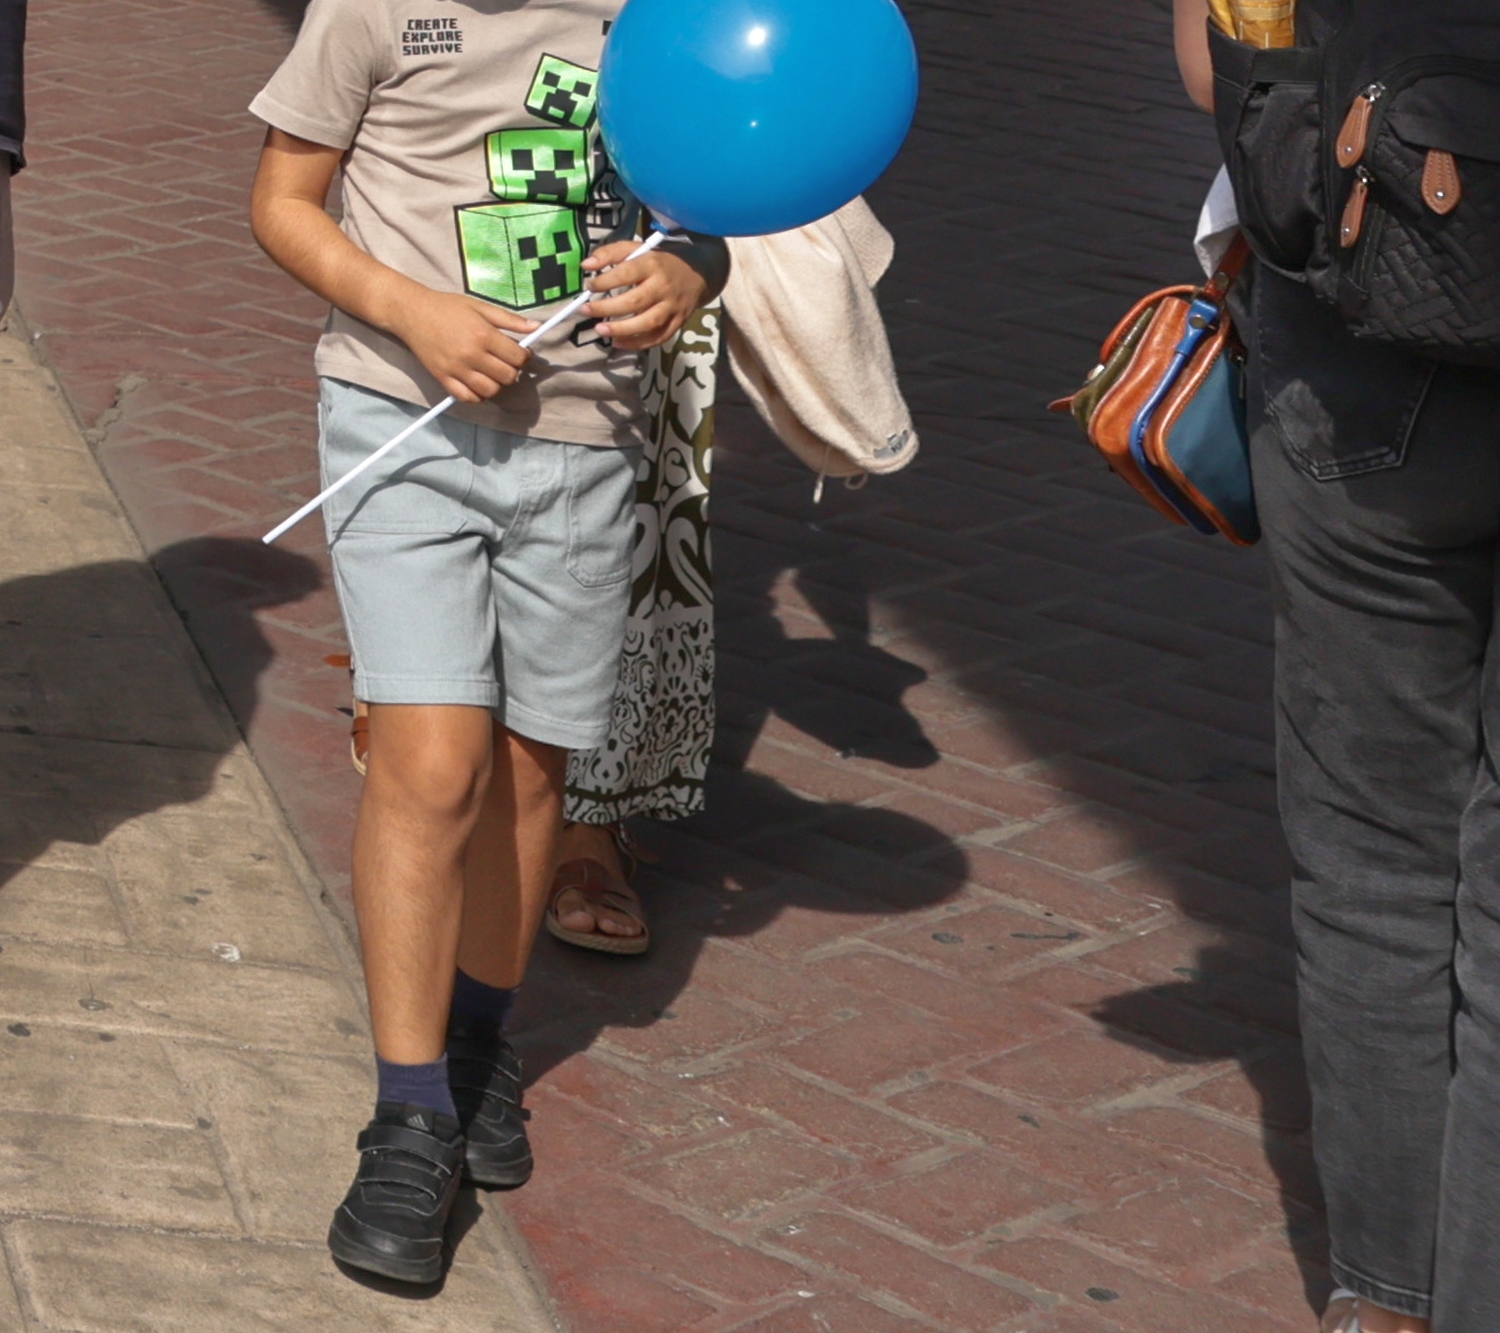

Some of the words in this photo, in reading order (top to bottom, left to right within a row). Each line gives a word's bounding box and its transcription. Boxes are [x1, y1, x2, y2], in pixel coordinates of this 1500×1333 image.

[407, 18, 458, 31] CREATE
[402, 31, 463, 43] EXPLORE
[402, 43, 463, 56] SURVIVE
